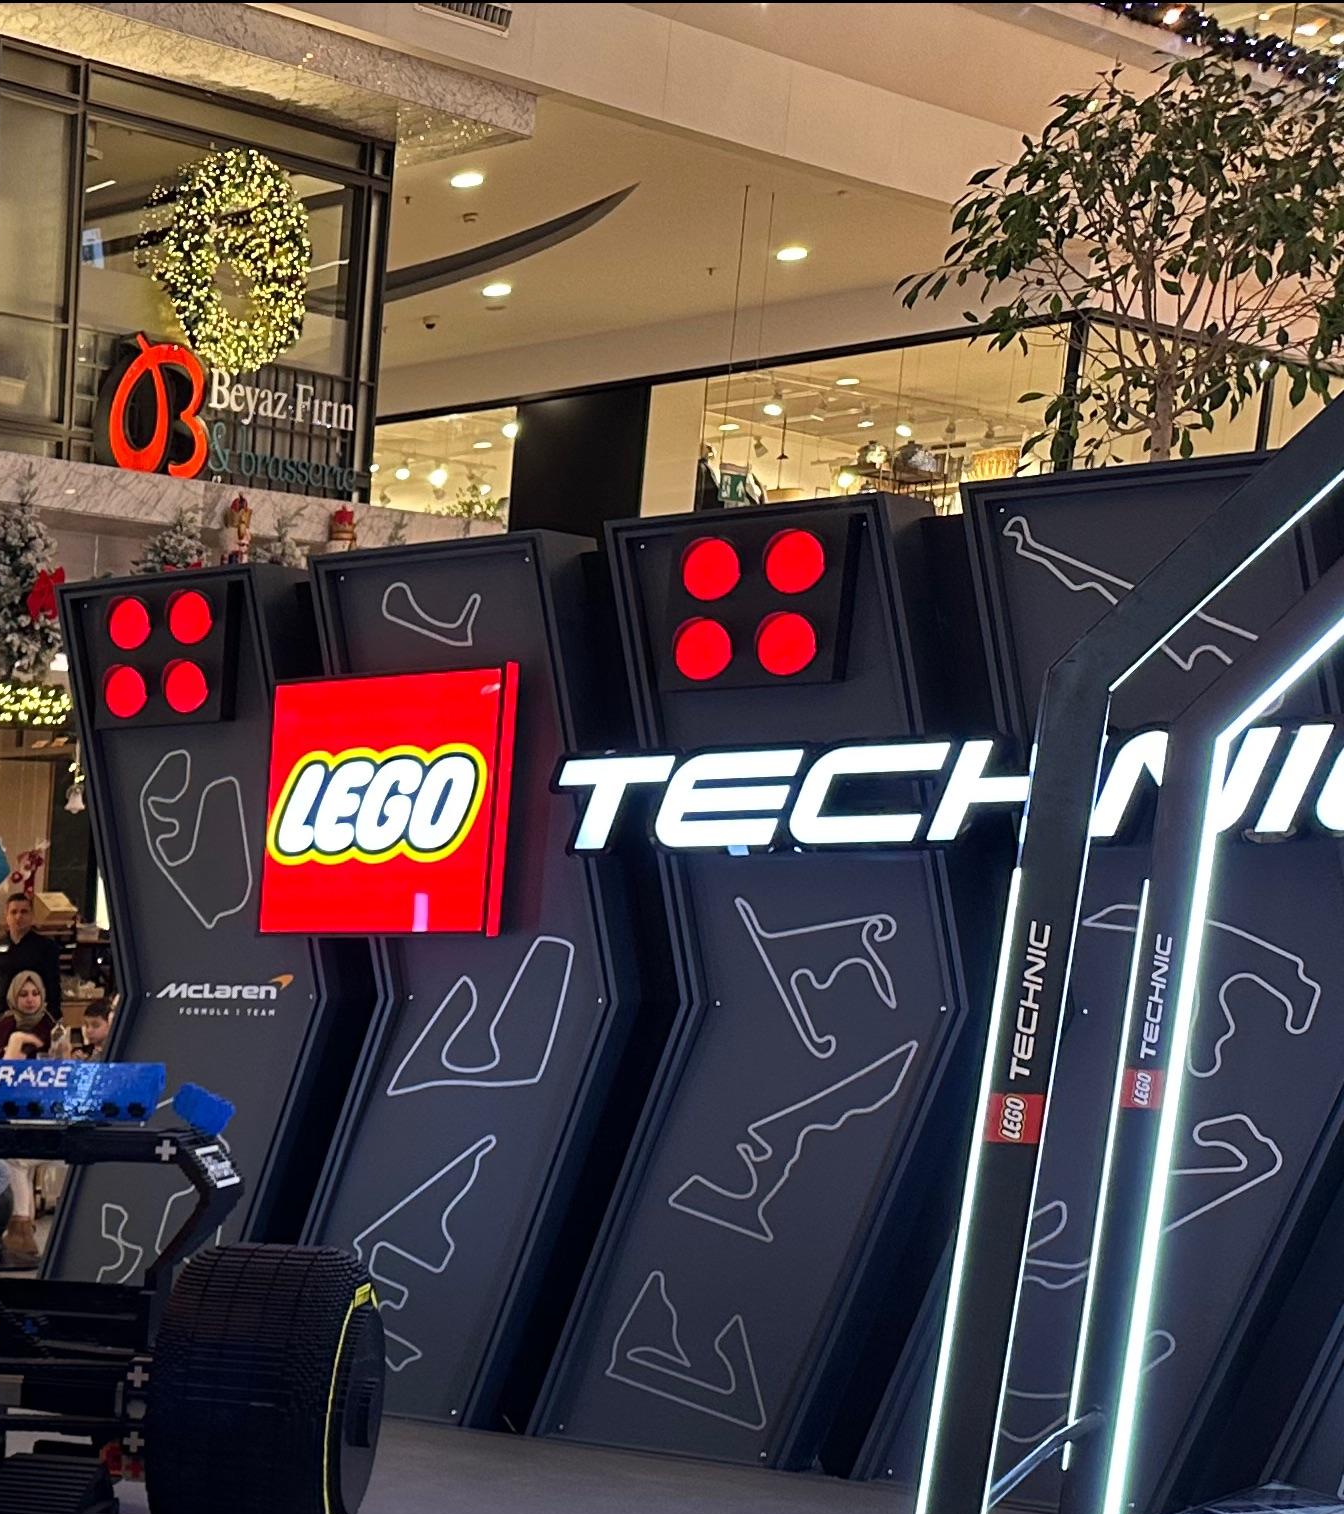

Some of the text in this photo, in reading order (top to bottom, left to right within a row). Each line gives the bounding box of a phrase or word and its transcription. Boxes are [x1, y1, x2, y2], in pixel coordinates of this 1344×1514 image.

[208, 367, 289, 426] Beyaz
[273, 749, 480, 859] LEGO
[155, 982, 278, 1000] McLaren
[179, 1007, 230, 1017] FORMULA
[246, 1008, 276, 1017] TEAM
[1009, 920, 1052, 1081] TECHNIC
[1139, 933, 1174, 1060] TECHNIC
[1131, 1070, 1153, 1107] LEGO
[999, 1094, 1027, 1143] LEGO
